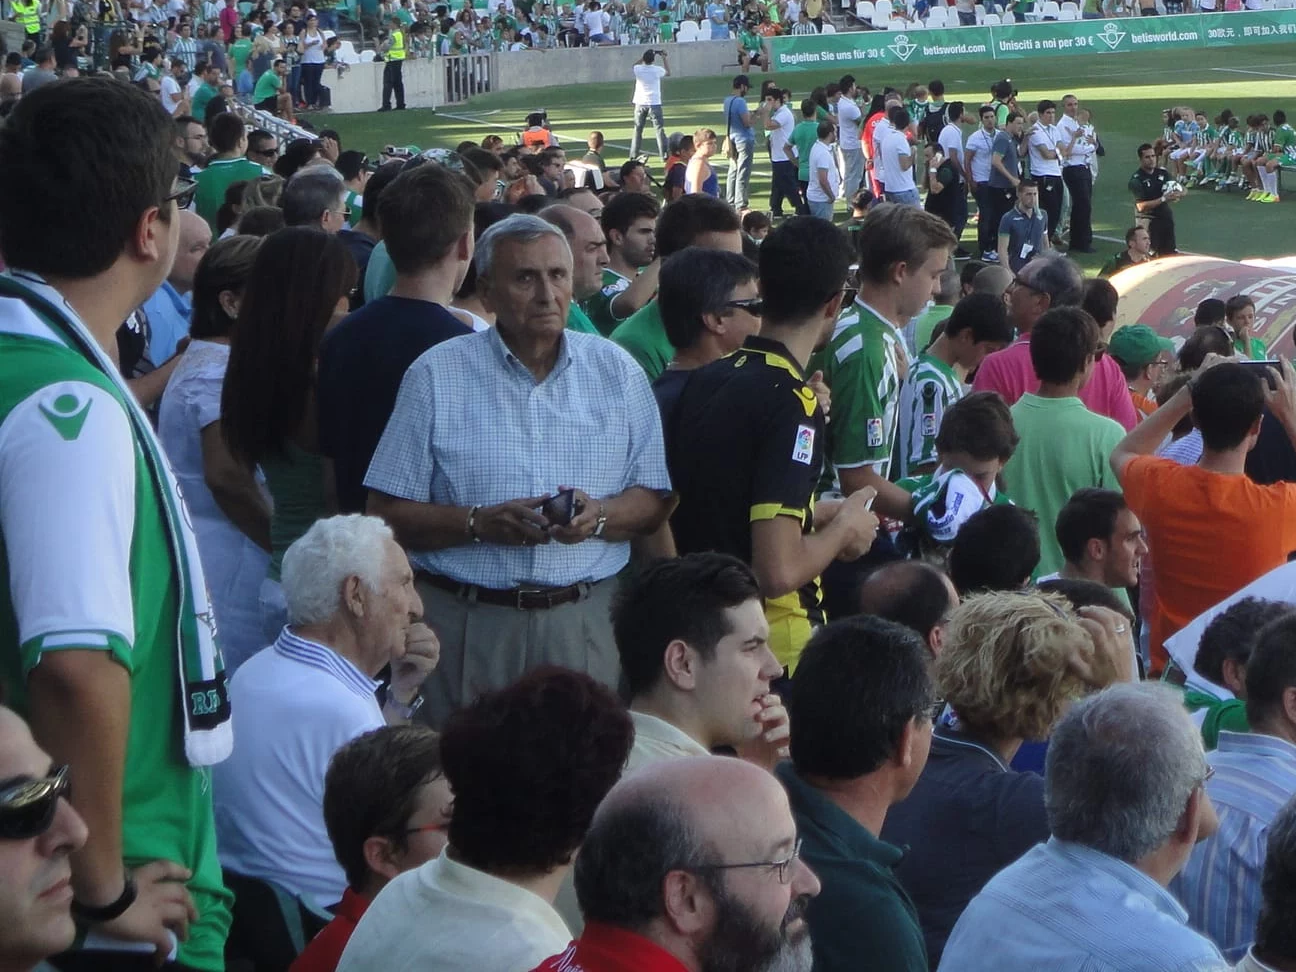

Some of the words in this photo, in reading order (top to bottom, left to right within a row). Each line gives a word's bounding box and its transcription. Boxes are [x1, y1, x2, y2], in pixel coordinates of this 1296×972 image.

[1000, 38, 1032, 51] Unisciti
[1034, 41, 1041, 49] a
[1042, 38, 1056, 49] noi
[1058, 38, 1073, 50] per
[1074, 36, 1086, 46] 30
[1131, 30, 1198, 44] betisworld.com
[780, 52, 820, 64] Begleiten
[821, 51, 835, 61] Sie
[836, 51, 852, 60] uns
[853, 49, 866, 59] für
[867, 48, 878, 58] 30
[922, 43, 986, 56] betisworld.com
